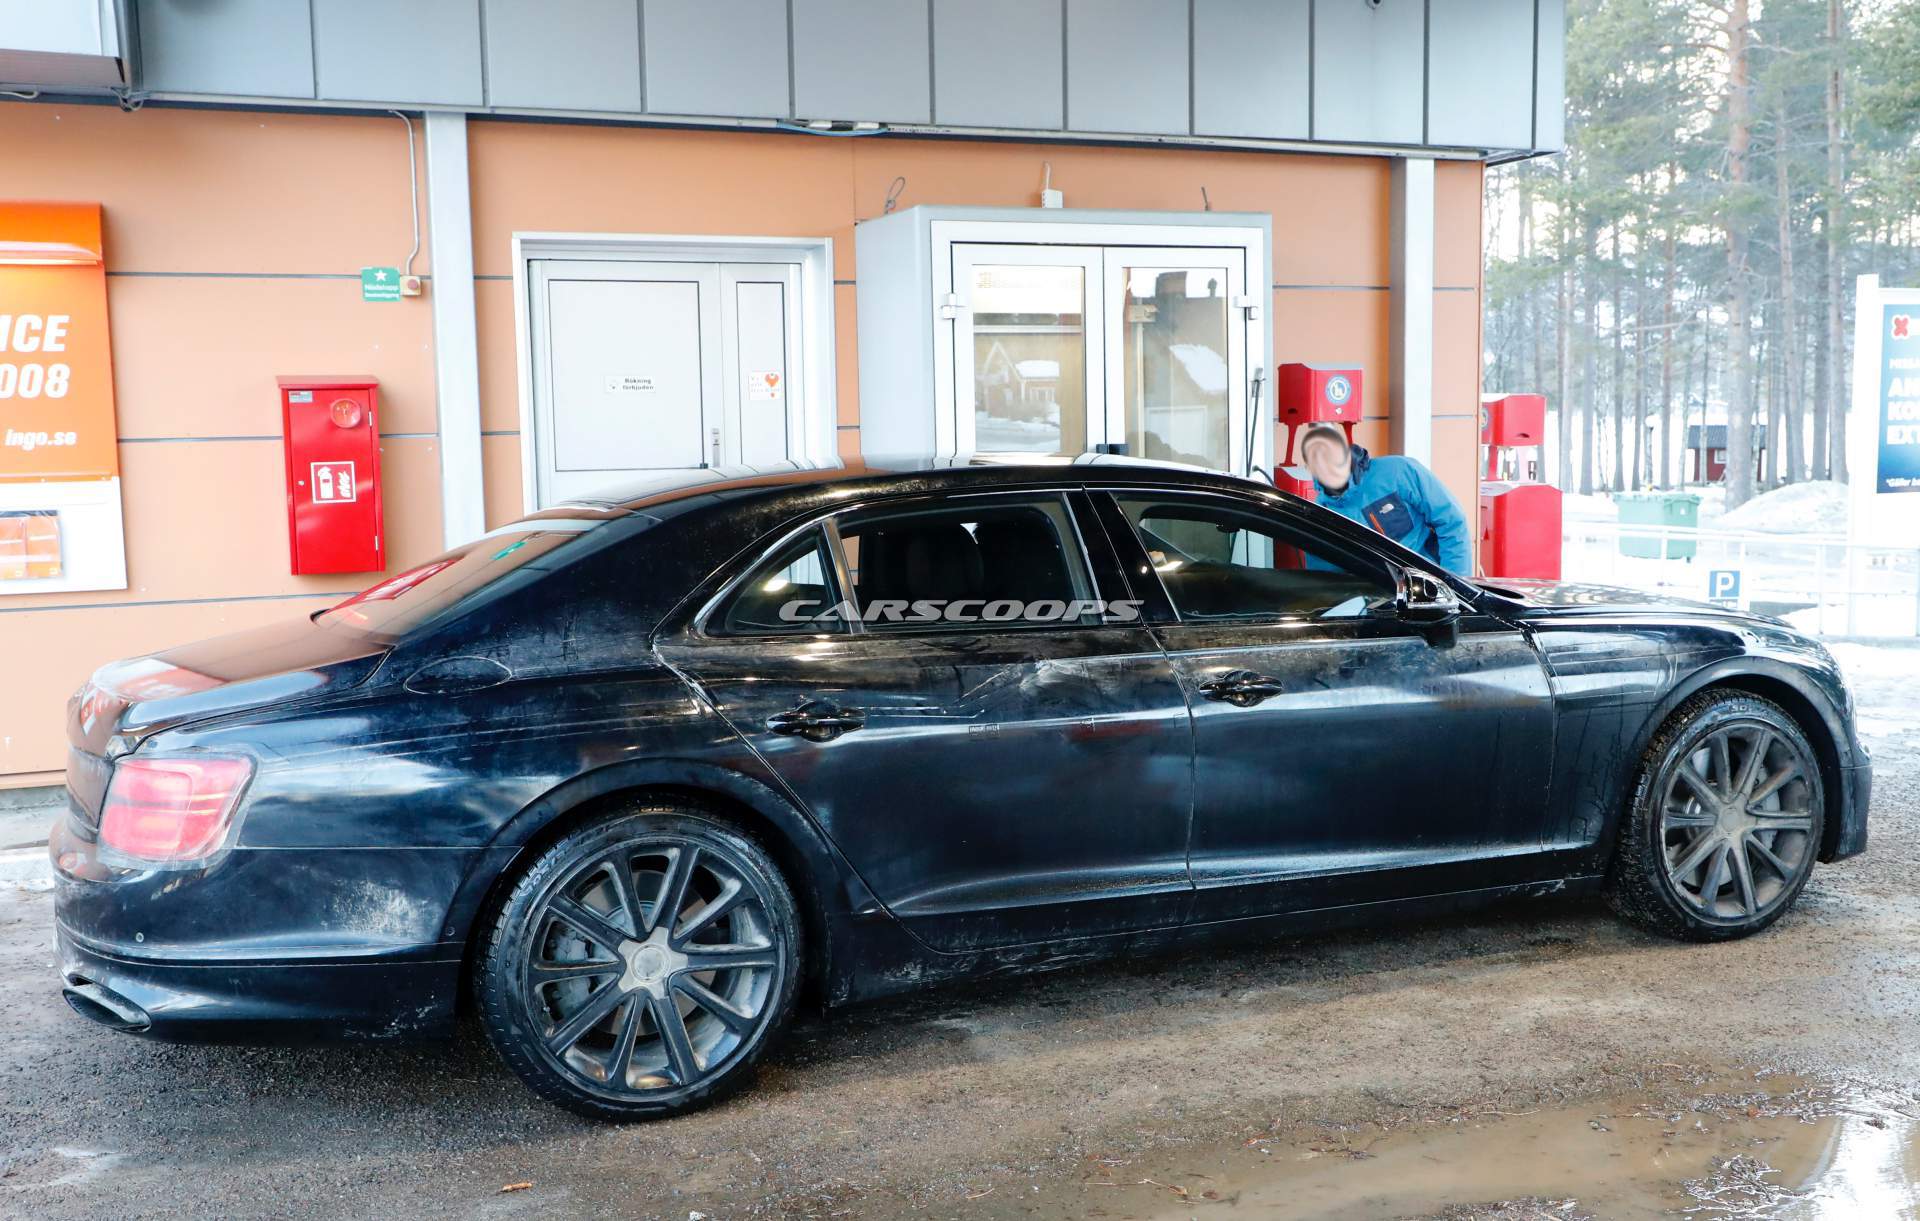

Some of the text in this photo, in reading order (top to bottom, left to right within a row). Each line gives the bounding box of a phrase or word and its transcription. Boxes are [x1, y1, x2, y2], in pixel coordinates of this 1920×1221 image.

[0, 363, 71, 398] 008
[5, 428, 77, 451] ingo.se
[1715, 572, 1735, 598] P
